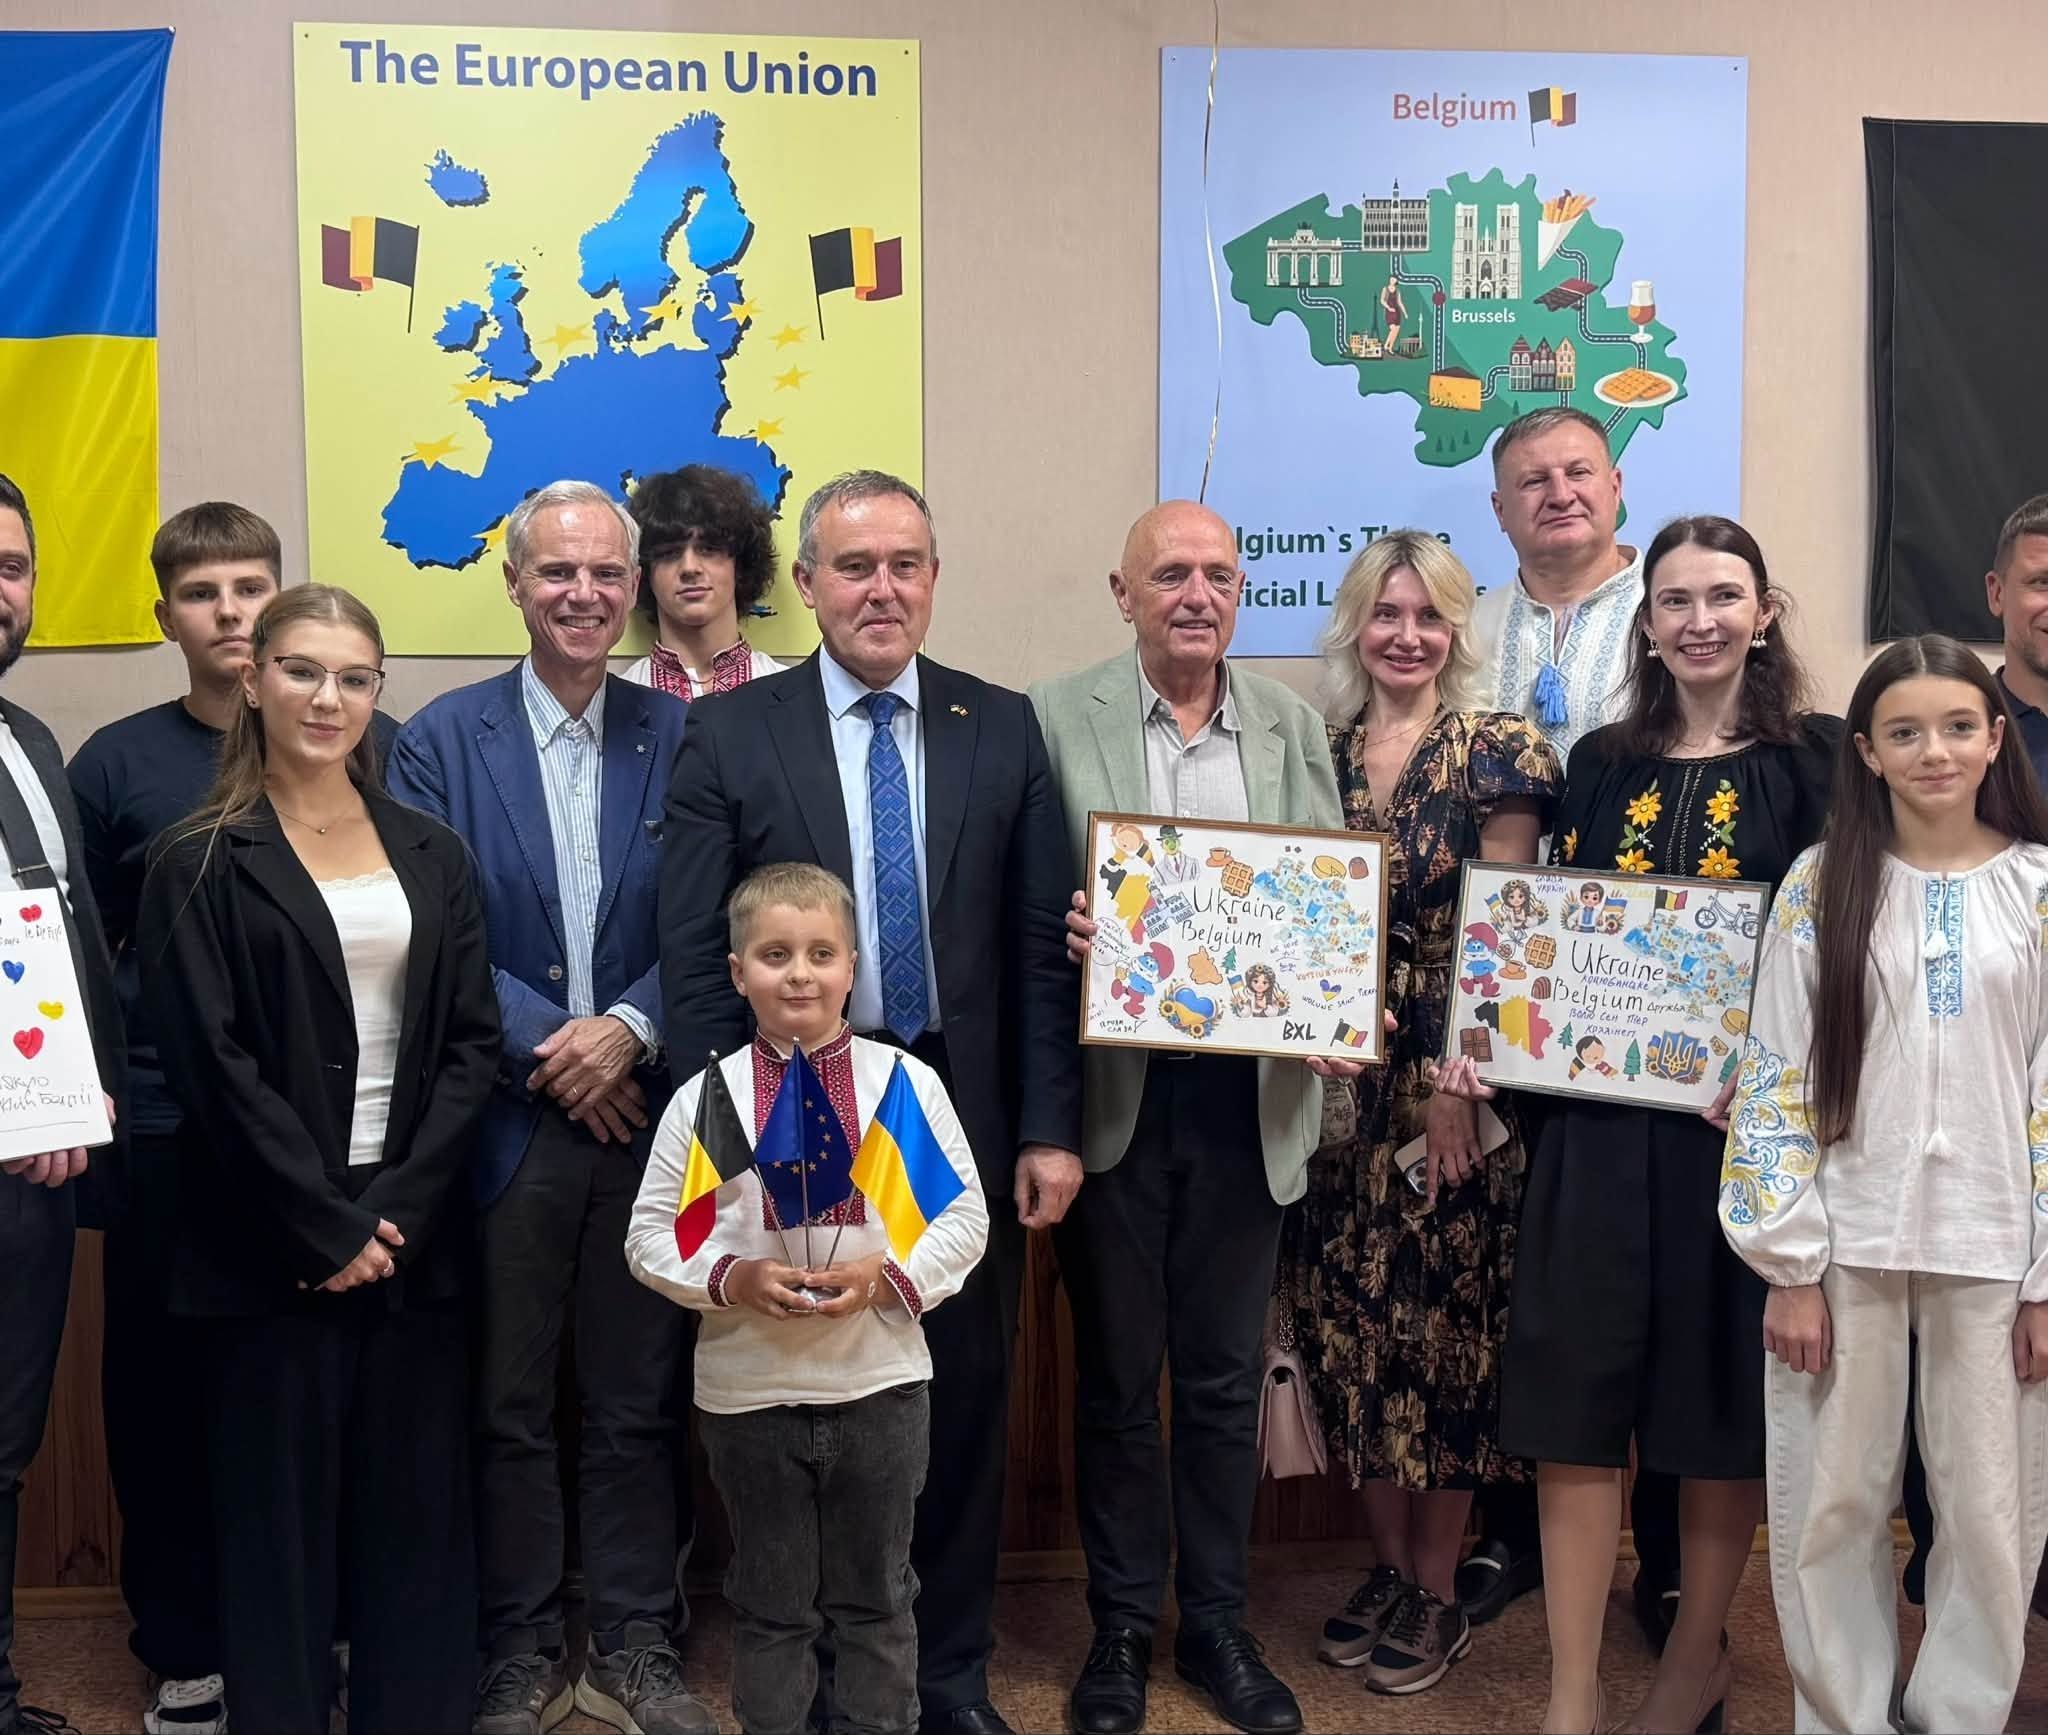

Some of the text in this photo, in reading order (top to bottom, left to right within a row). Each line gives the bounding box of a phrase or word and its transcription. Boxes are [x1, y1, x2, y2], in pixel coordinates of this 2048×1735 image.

[340, 39, 878, 101] The European Union
[1393, 92, 1517, 128] Belgium
[1452, 307, 1517, 323] Brussels
[1236, 526, 1353, 561] lgium`s
[1193, 885, 1286, 921] Ukraine
[1181, 919, 1262, 952] Belgium
[1571, 939, 1665, 981] Ukraine
[1552, 976, 1643, 1014] Belgium
[1283, 1019, 1318, 1041] BXL
